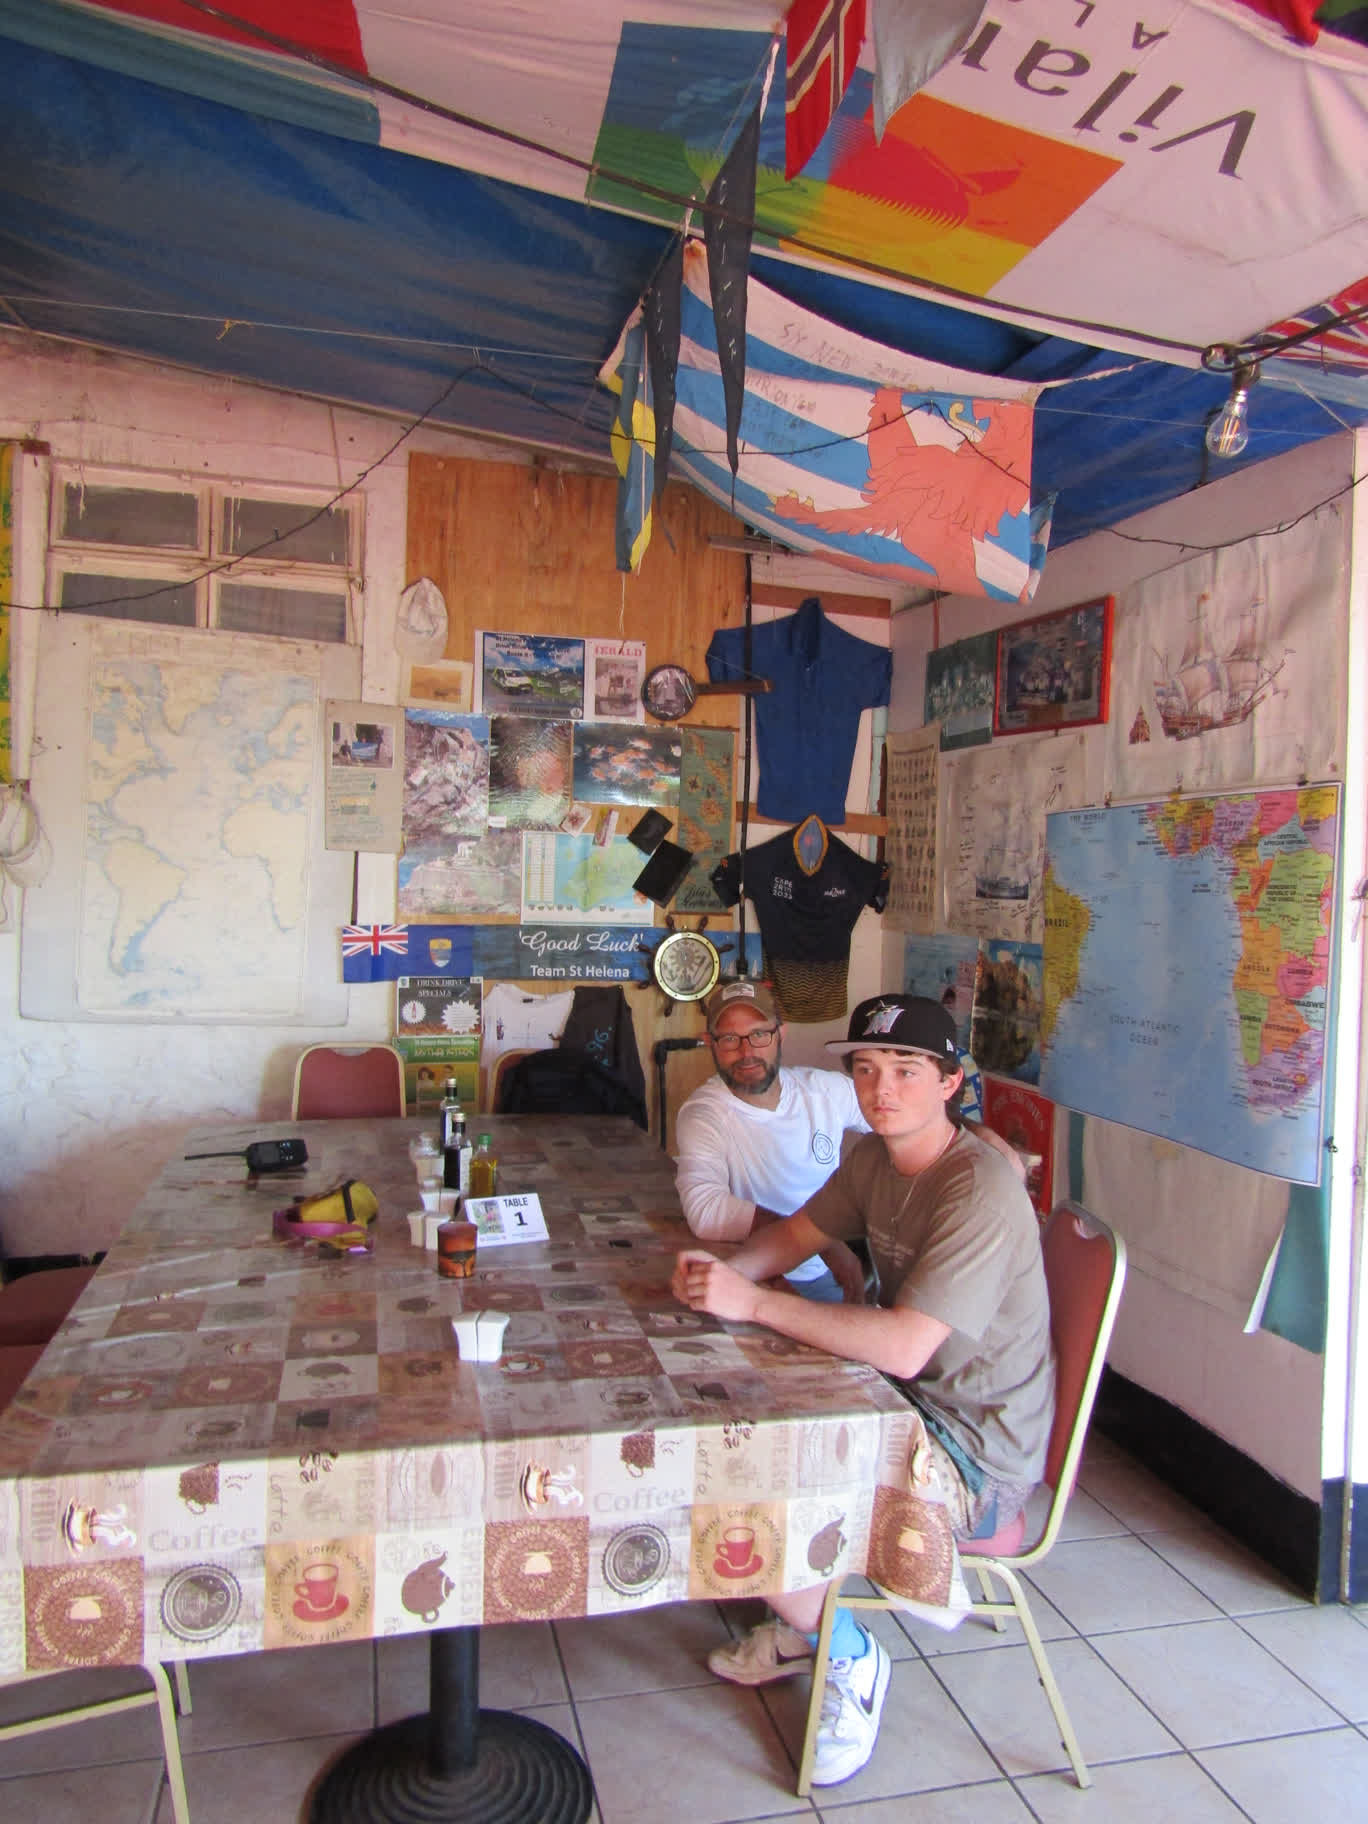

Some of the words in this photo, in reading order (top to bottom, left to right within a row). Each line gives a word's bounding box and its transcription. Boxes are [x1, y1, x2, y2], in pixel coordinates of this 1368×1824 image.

[530, 965, 566, 977] Team
[569, 965, 583, 977] St
[585, 965, 630, 978] Helena
[503, 1197, 529, 1208] TABLE
[514, 1211, 528, 1226] 1
[594, 1487, 687, 1513] Coffee
[150, 1523, 259, 1553] Coffee
